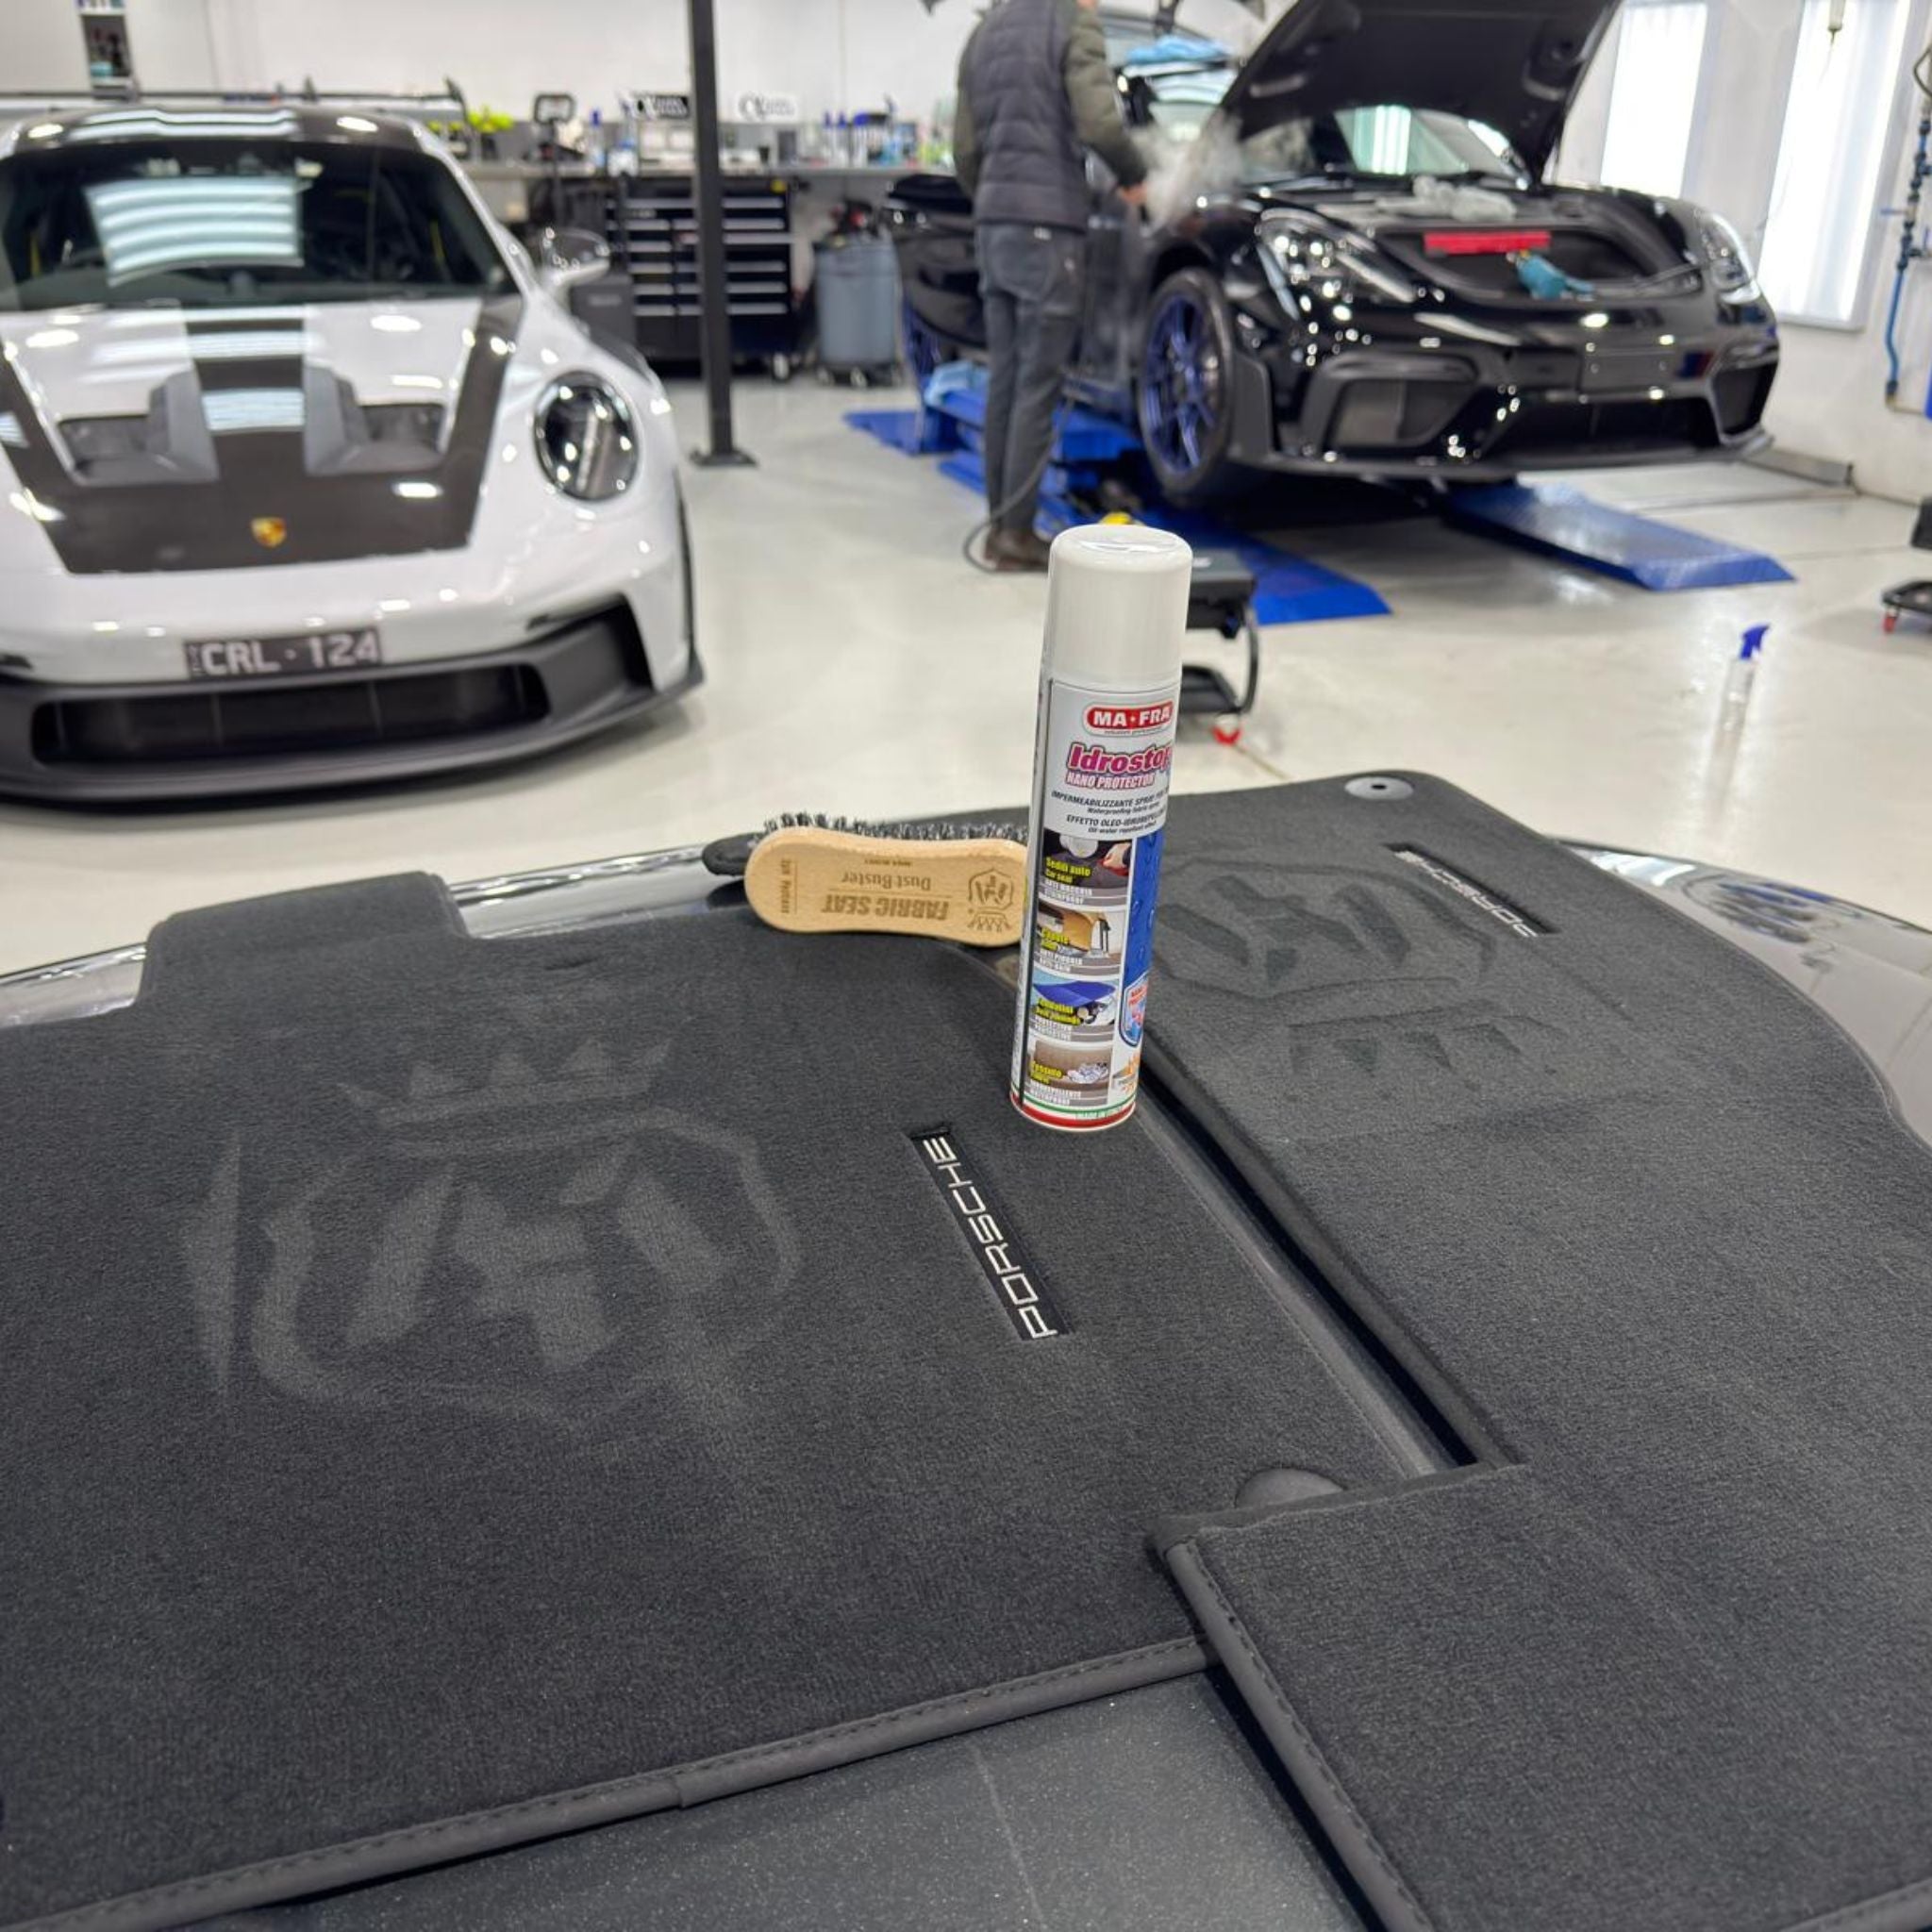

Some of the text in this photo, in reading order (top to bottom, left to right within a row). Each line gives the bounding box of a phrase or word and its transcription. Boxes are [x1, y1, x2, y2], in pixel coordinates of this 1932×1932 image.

[1066, 771, 1094, 789] NANO
[1051, 791, 1133, 808] IMPERMEABILIZZANTE
[1066, 814, 1099, 826] EFFETTO
[1070, 865, 1091, 877] auto
[841, 871, 932, 891] Dust Buster
[1394, 850, 1539, 938] PORSCHE
[820, 894, 950, 922] FABRIC SEAT
[922, 1136, 1058, 1339] PORSCHE
